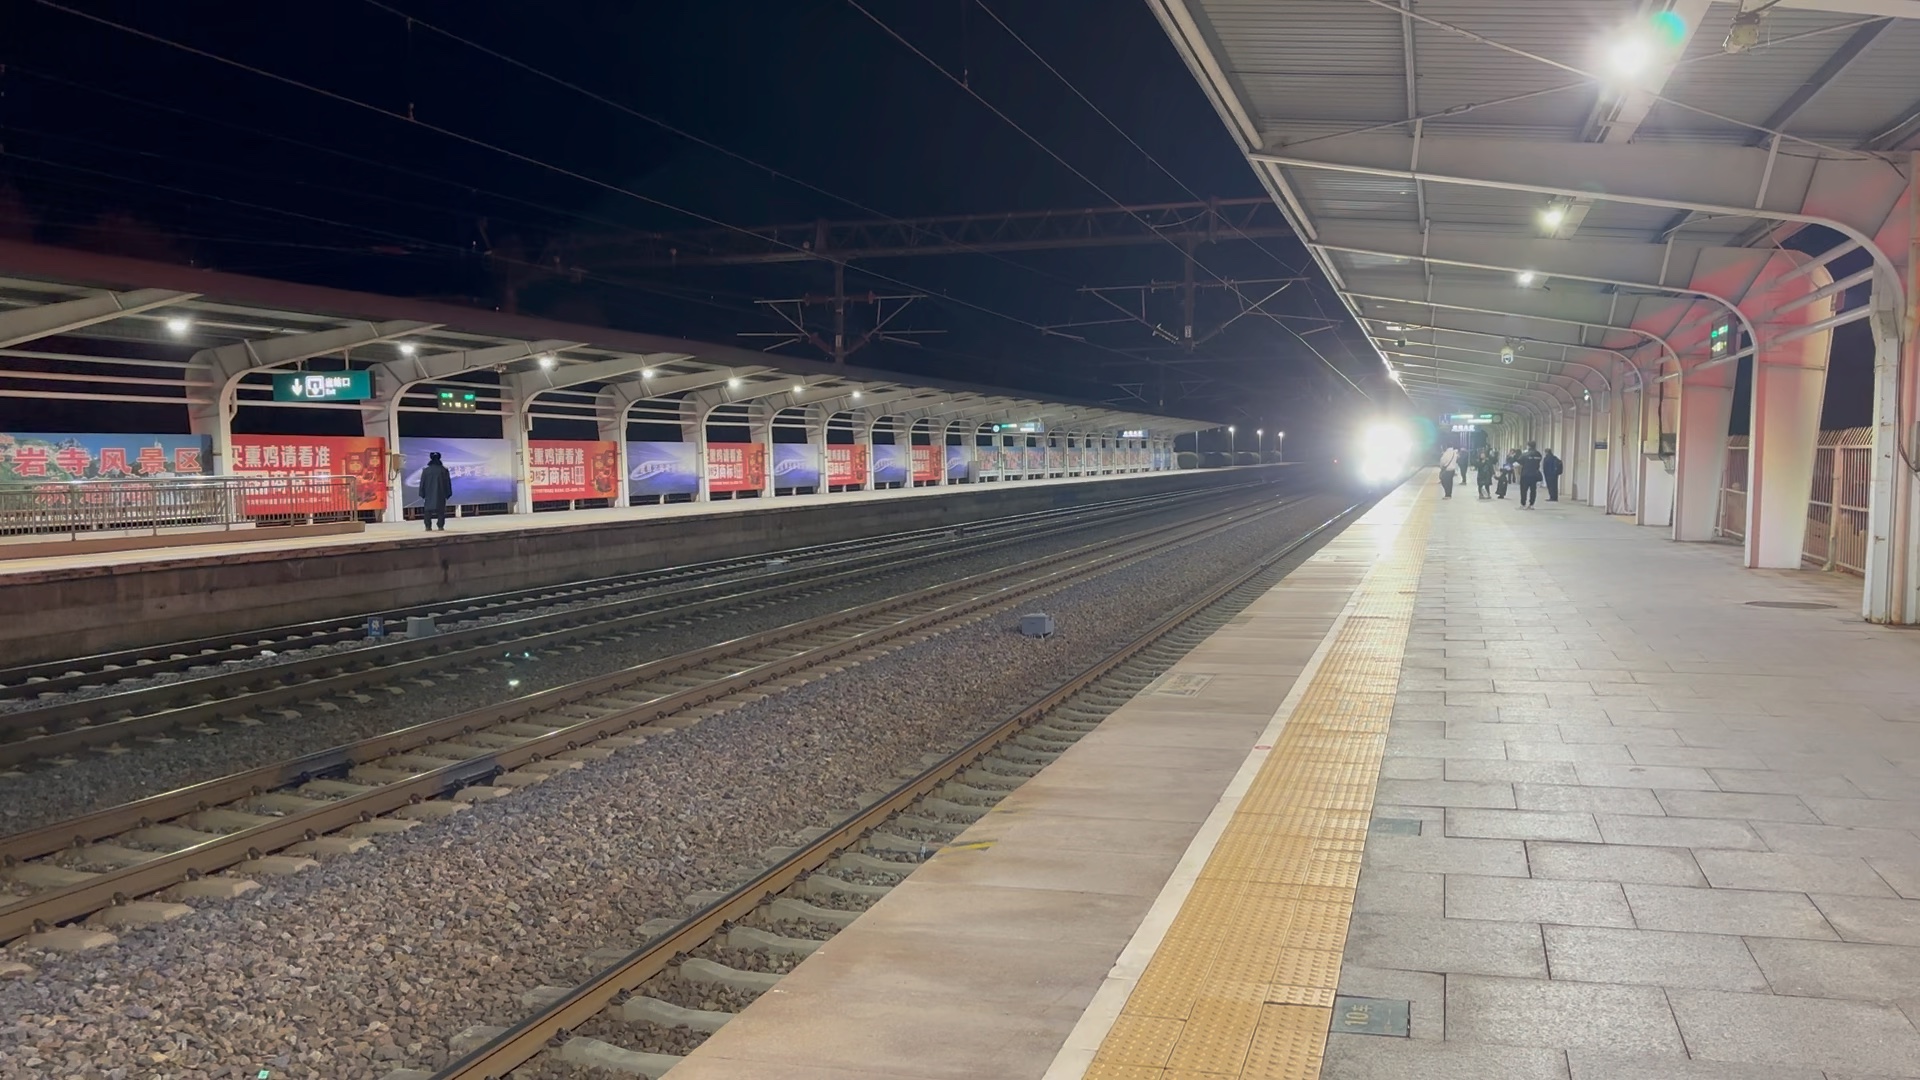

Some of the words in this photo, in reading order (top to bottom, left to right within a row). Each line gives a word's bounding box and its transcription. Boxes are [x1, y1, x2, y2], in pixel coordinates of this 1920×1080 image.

[0, 447, 202, 477] 岩寺风景区
